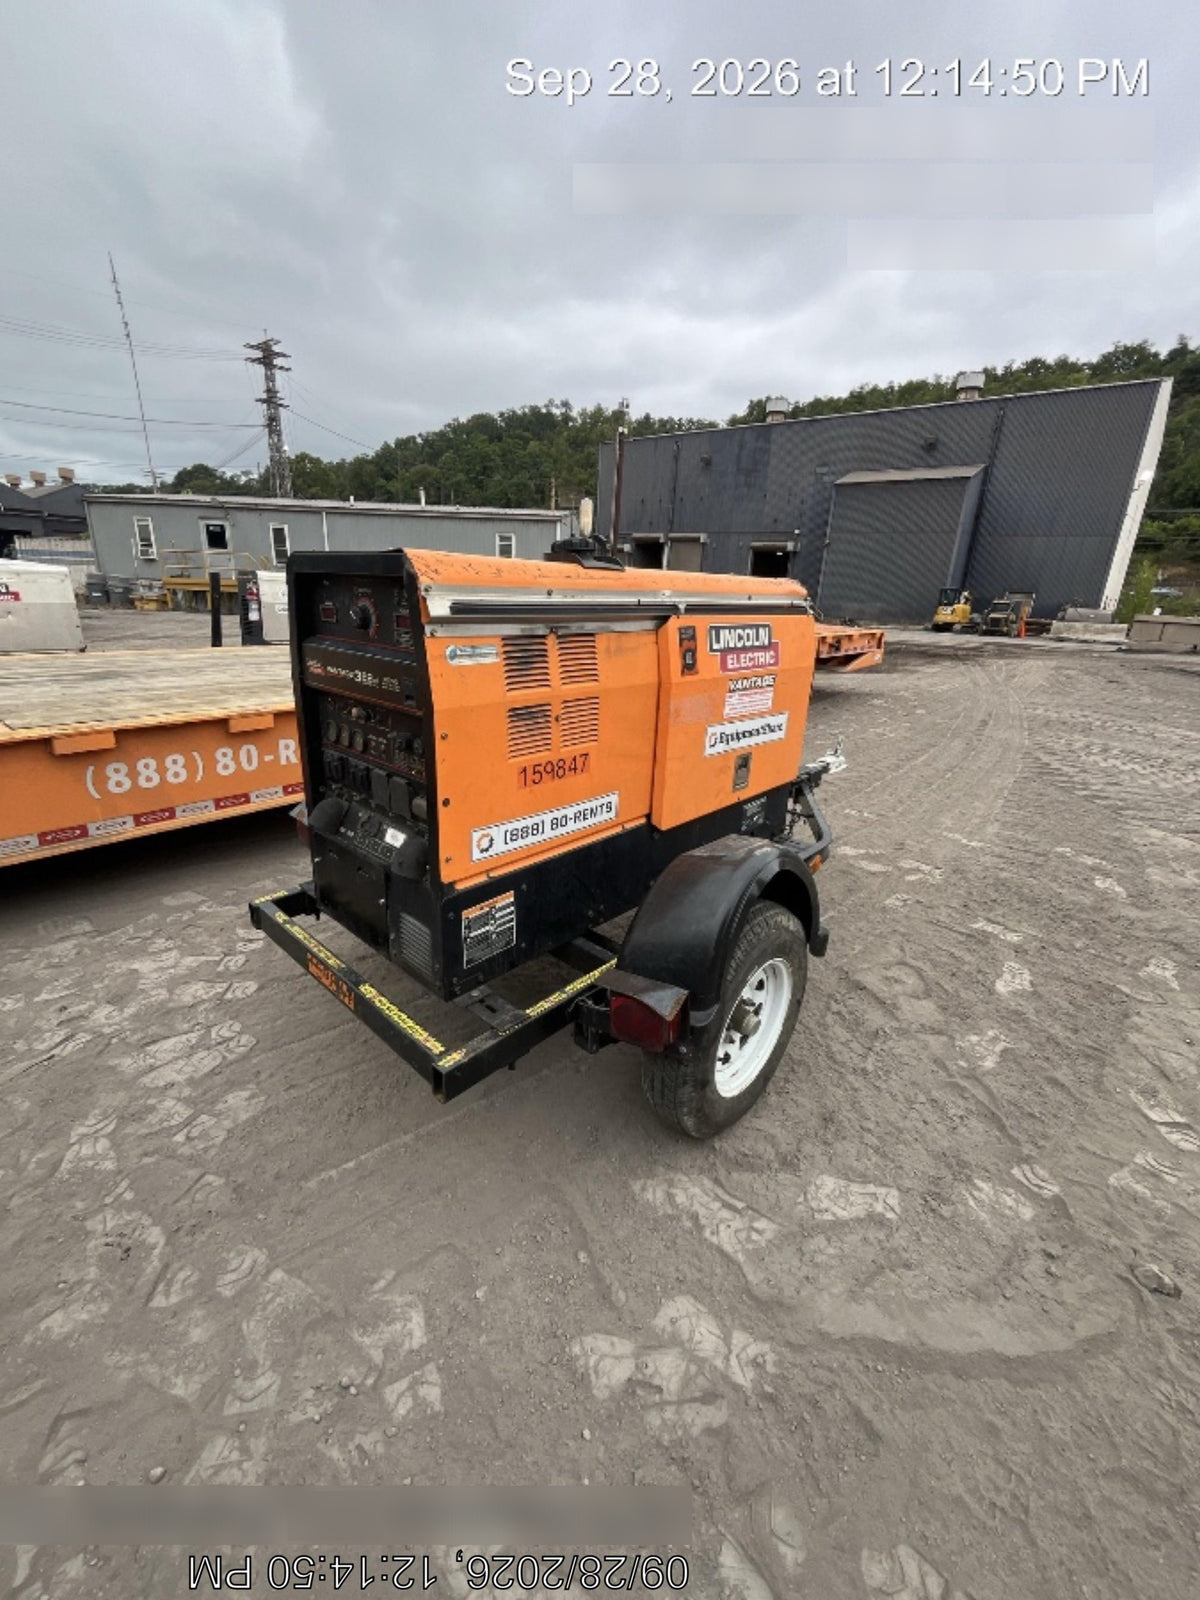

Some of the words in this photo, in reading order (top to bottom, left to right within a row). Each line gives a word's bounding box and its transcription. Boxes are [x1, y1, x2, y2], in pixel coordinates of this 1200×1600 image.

[712, 627, 770, 650] LINCOLN
[726, 649, 776, 669] ELECTRIC
[729, 674, 776, 691] VANTAGE
[85, 751, 204, 799] (888)
[519, 753, 590, 788] 159847
[550, 801, 613, 831] 80-RENTS
